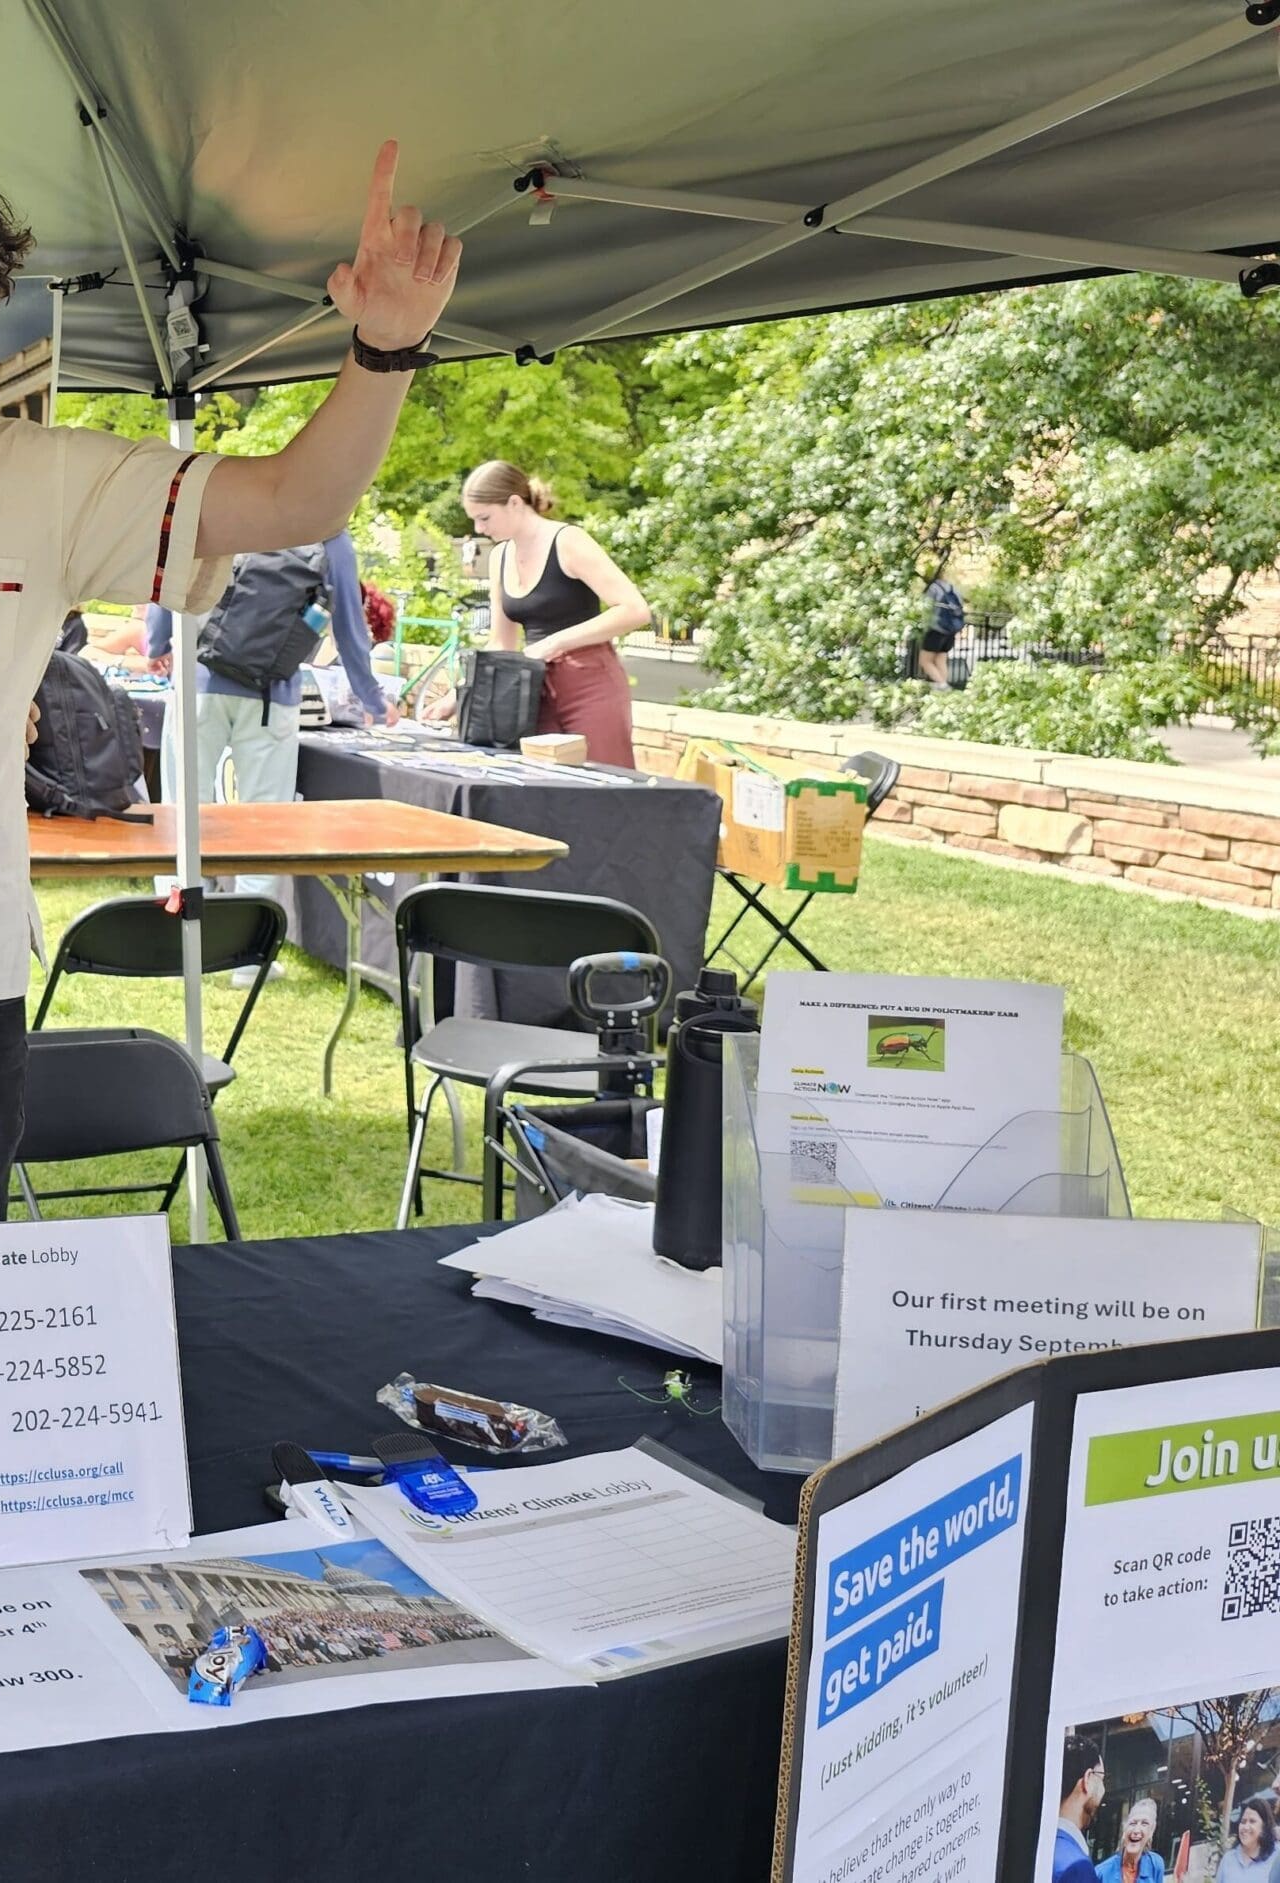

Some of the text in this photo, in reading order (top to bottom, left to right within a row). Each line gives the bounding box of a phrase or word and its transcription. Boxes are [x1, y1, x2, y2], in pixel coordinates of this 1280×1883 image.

[31, 1247, 79, 1266] Lobby
[892, 1290, 1206, 1321] Our first meeting will be on
[905, 1329, 1012, 1354] Thursday
[11, 1400, 163, 1433] 202-224-5941
[1145, 1429, 1280, 1487] Join u
[0, 1489, 135, 1515] https://cclusa.org/mcc
[522, 1490, 596, 1512] Climate
[597, 1477, 652, 1497] Lobby
[833, 1555, 894, 1617] Save
[898, 1525, 940, 1576] the
[944, 1473, 1016, 1545] world,
[1113, 1546, 1212, 1575] Scan QR code
[22, 1598, 53, 1612] on
[1103, 1578, 1209, 1607] to take action:
[20, 1620, 48, 1636] 4th
[824, 1657, 871, 1717] get
[876, 1601, 934, 1687] paid.
[29, 1667, 83, 1684] 300.
[819, 1654, 989, 1791] (Just kidding, it’s volunteer)
[830, 1848, 869, 1883] believe
[870, 1833, 892, 1857] that
[894, 1817, 912, 1839] the
[913, 1796, 936, 1824] only
[938, 1777, 959, 1806] way
[960, 1771, 971, 1788] to
[885, 1835, 923, 1875] change
[925, 1826, 934, 1845] is
[936, 1793, 981, 1834] together.
[933, 1821, 981, 1865] concerns,
[945, 1855, 966, 1881] with
